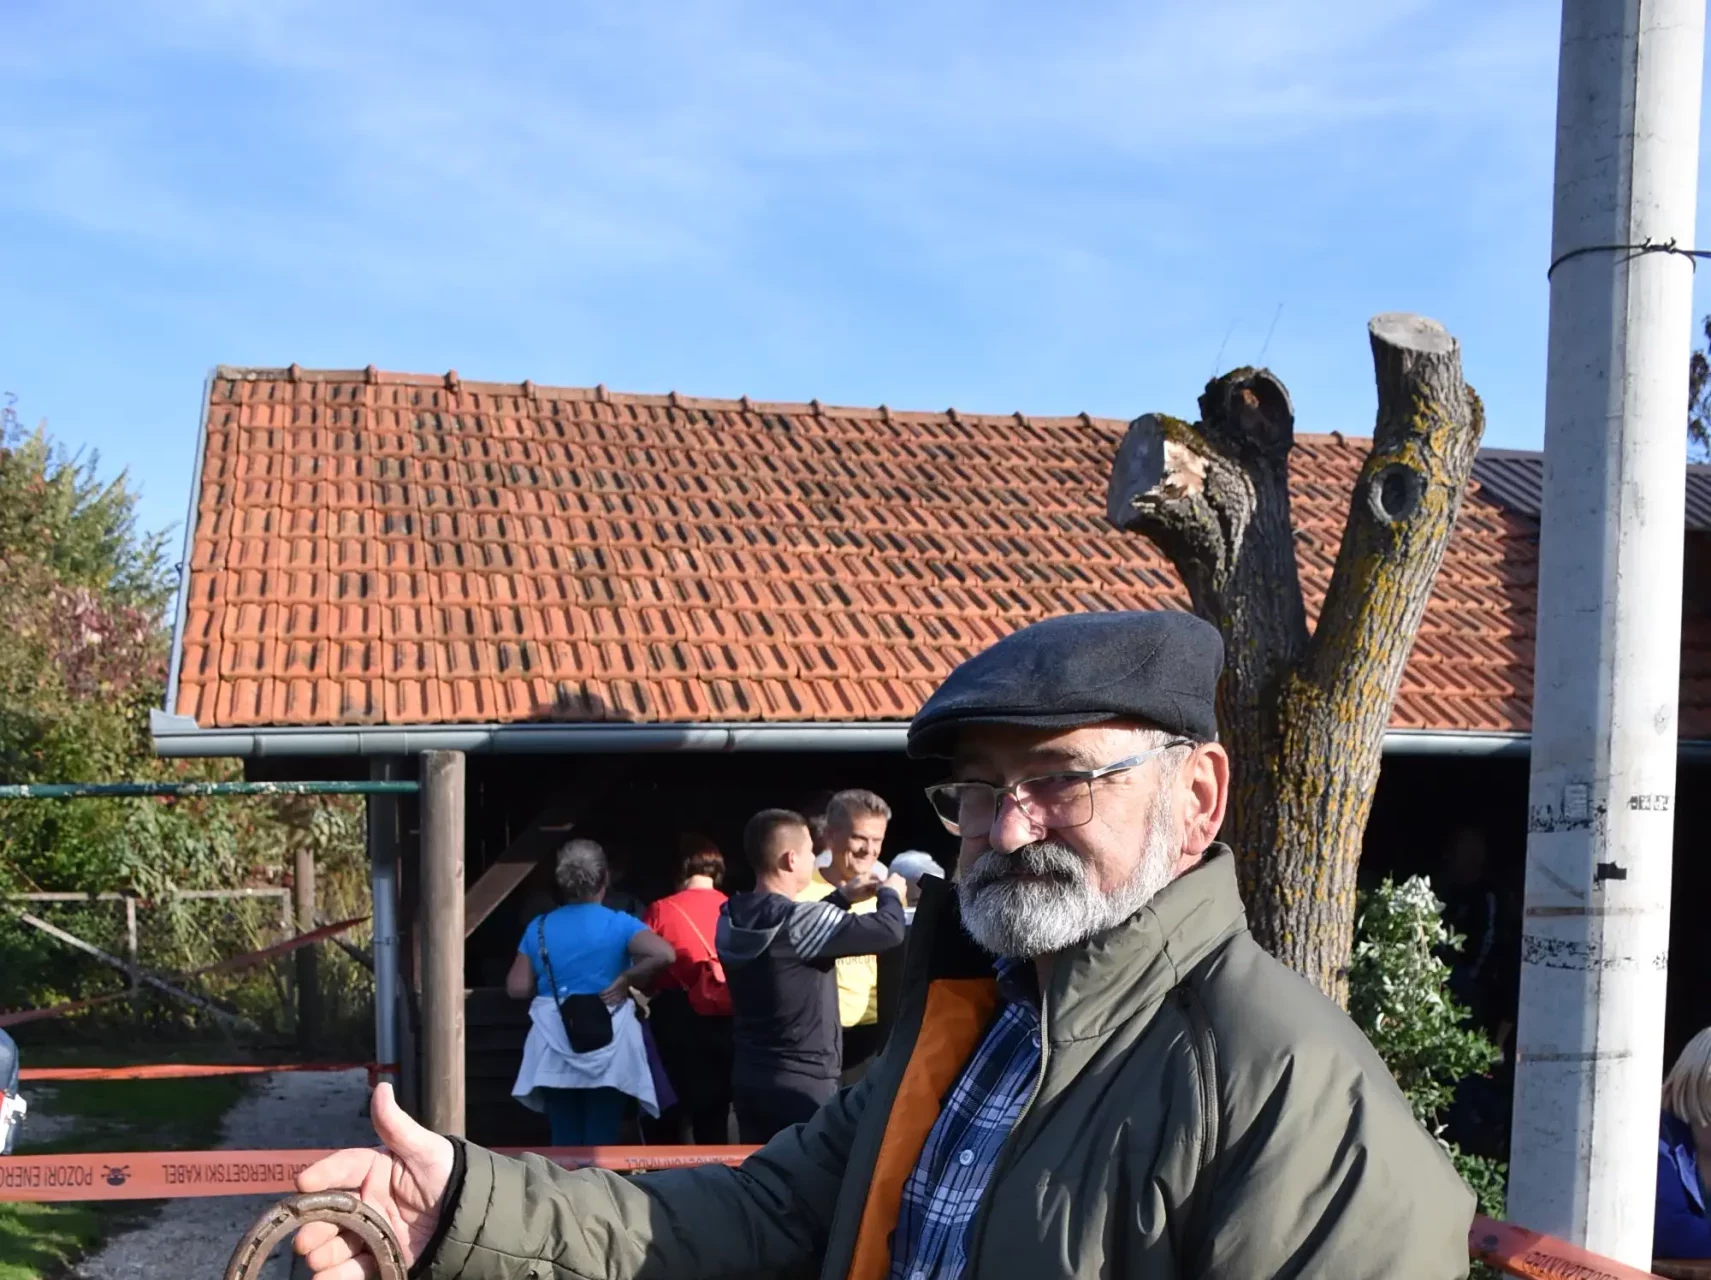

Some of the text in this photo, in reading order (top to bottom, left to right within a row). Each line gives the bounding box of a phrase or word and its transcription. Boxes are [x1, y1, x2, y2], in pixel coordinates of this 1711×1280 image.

[44, 1164, 93, 1187] POZOR!
[162, 1164, 201, 1184] KABEL
[205, 1163, 284, 1183] ENERGETSKI
